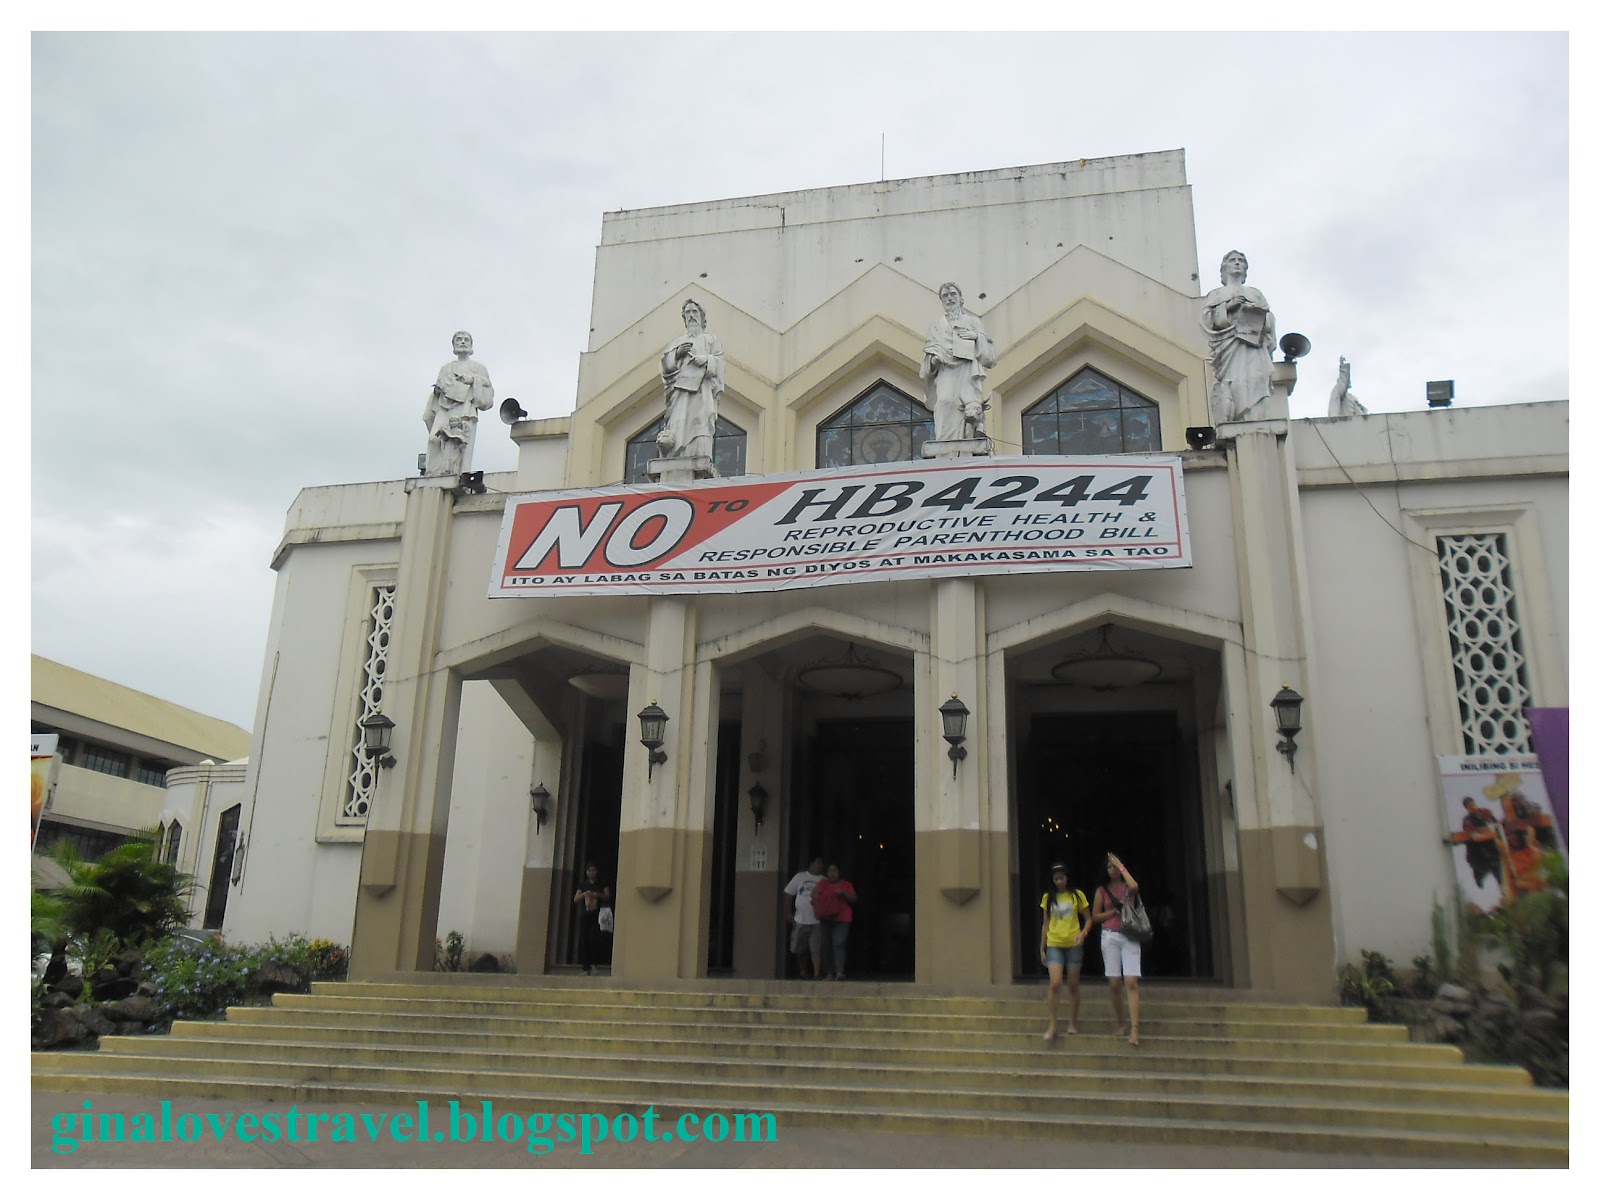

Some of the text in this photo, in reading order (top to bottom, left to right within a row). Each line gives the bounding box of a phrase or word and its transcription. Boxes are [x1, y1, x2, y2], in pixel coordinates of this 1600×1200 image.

[512, 475, 1154, 571] NO TO HB4244
[784, 511, 1157, 542] REPRODUCTIVE HEALTH &
[698, 527, 1159, 563] RESPONSIBLE PARENTHOOD BILL
[512, 547, 1169, 585] ITO AY LABAG SA BATAS NG DIYOS AT MAKAKASAMA SA TAO
